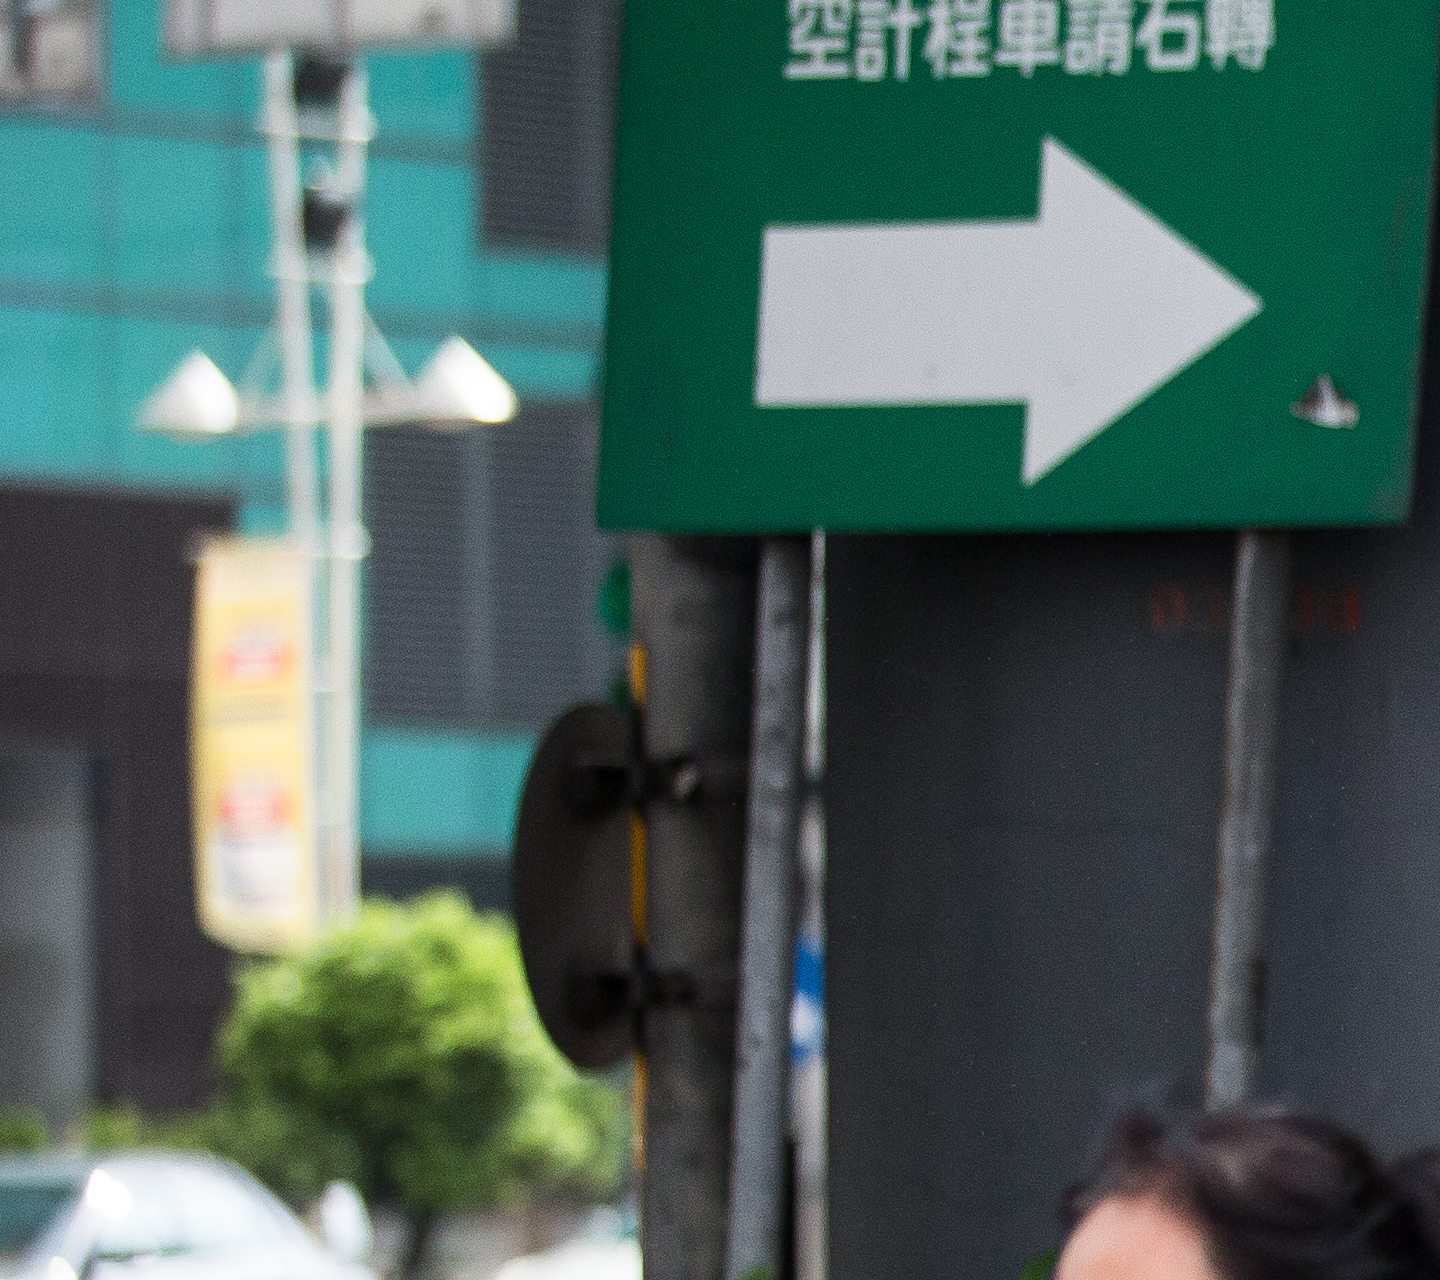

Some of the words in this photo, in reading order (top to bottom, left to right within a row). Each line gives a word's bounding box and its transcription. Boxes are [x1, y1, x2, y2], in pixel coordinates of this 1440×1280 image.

[782, 0, 1275, 81] 空計程車請右轉
